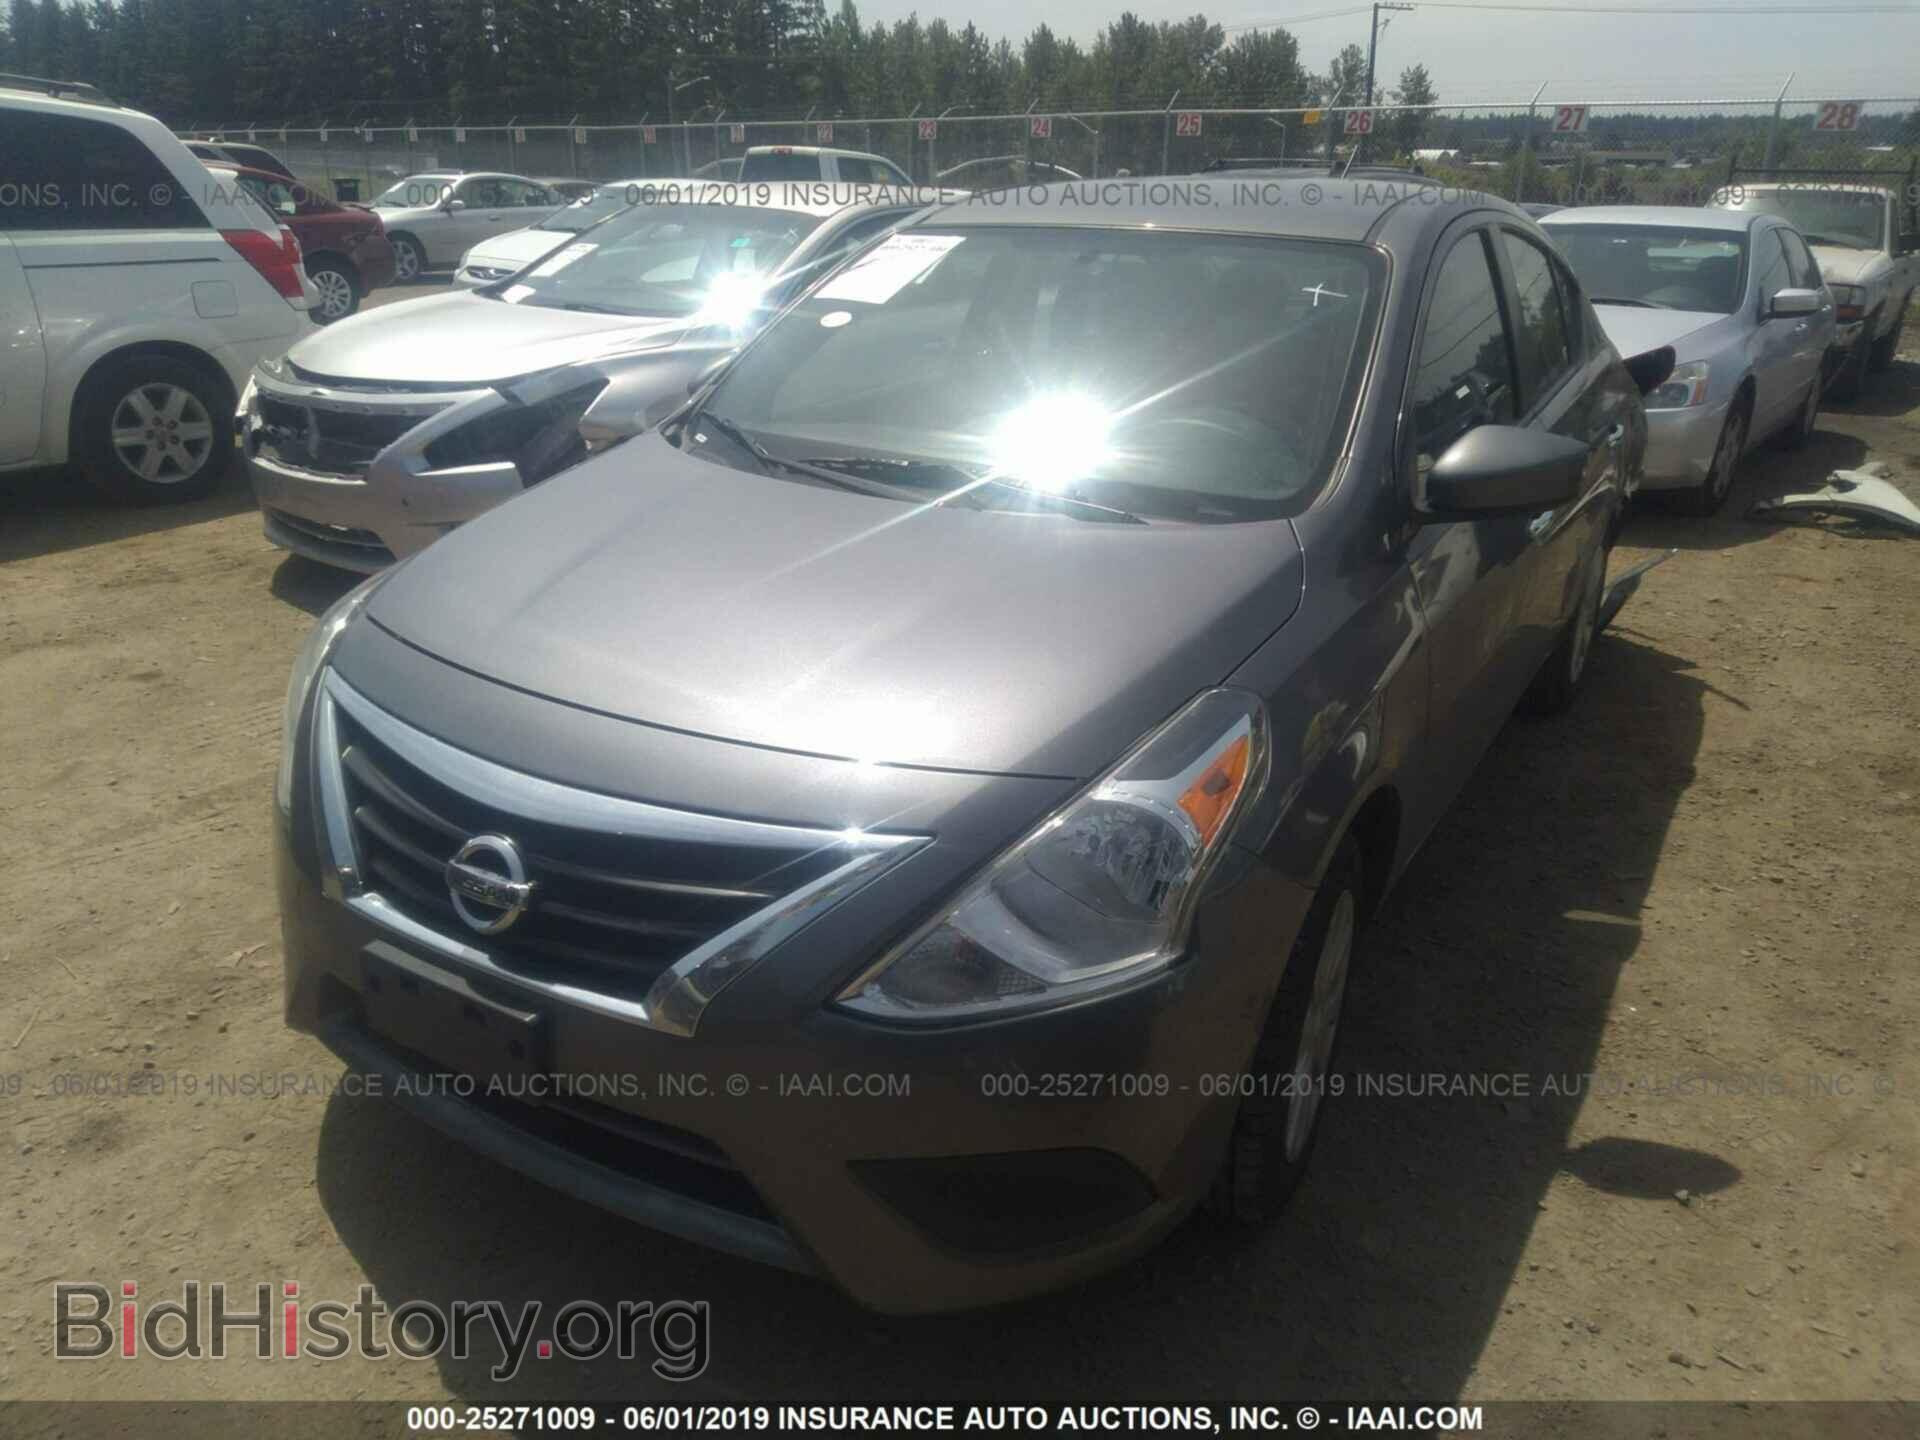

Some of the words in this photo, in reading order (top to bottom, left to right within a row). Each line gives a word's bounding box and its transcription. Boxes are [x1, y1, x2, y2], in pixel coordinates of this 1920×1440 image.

[1033, 117, 1049, 136] 24
[1179, 113, 1200, 135] 25
[1347, 111, 1371, 133] 26
[1555, 107, 1586, 130] 27
[1818, 103, 1857, 129] 28
[919, 120, 935, 138] 23
